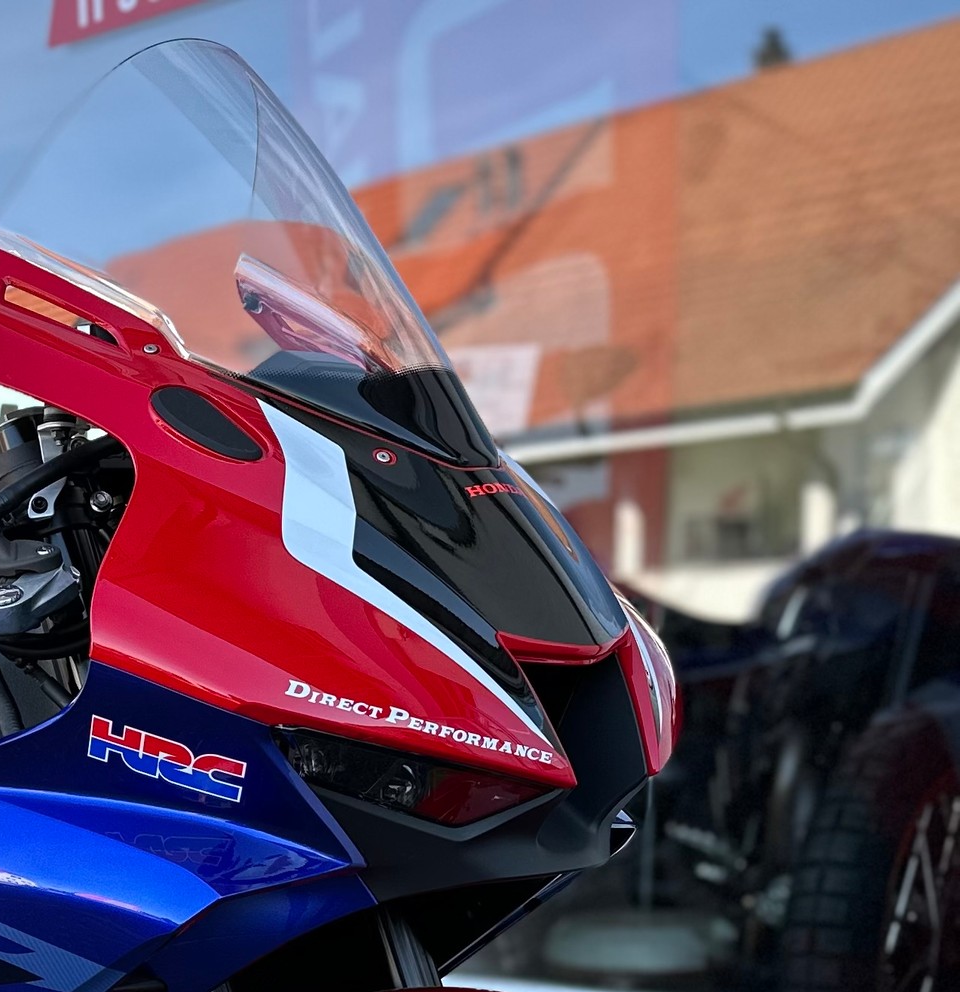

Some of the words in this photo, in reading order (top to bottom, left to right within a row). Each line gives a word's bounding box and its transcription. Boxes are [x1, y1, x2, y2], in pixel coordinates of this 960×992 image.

[87, 714, 247, 803] HRC
[284, 679, 383, 719] DIRECT
[385, 705, 553, 765] PERFORMANCE
